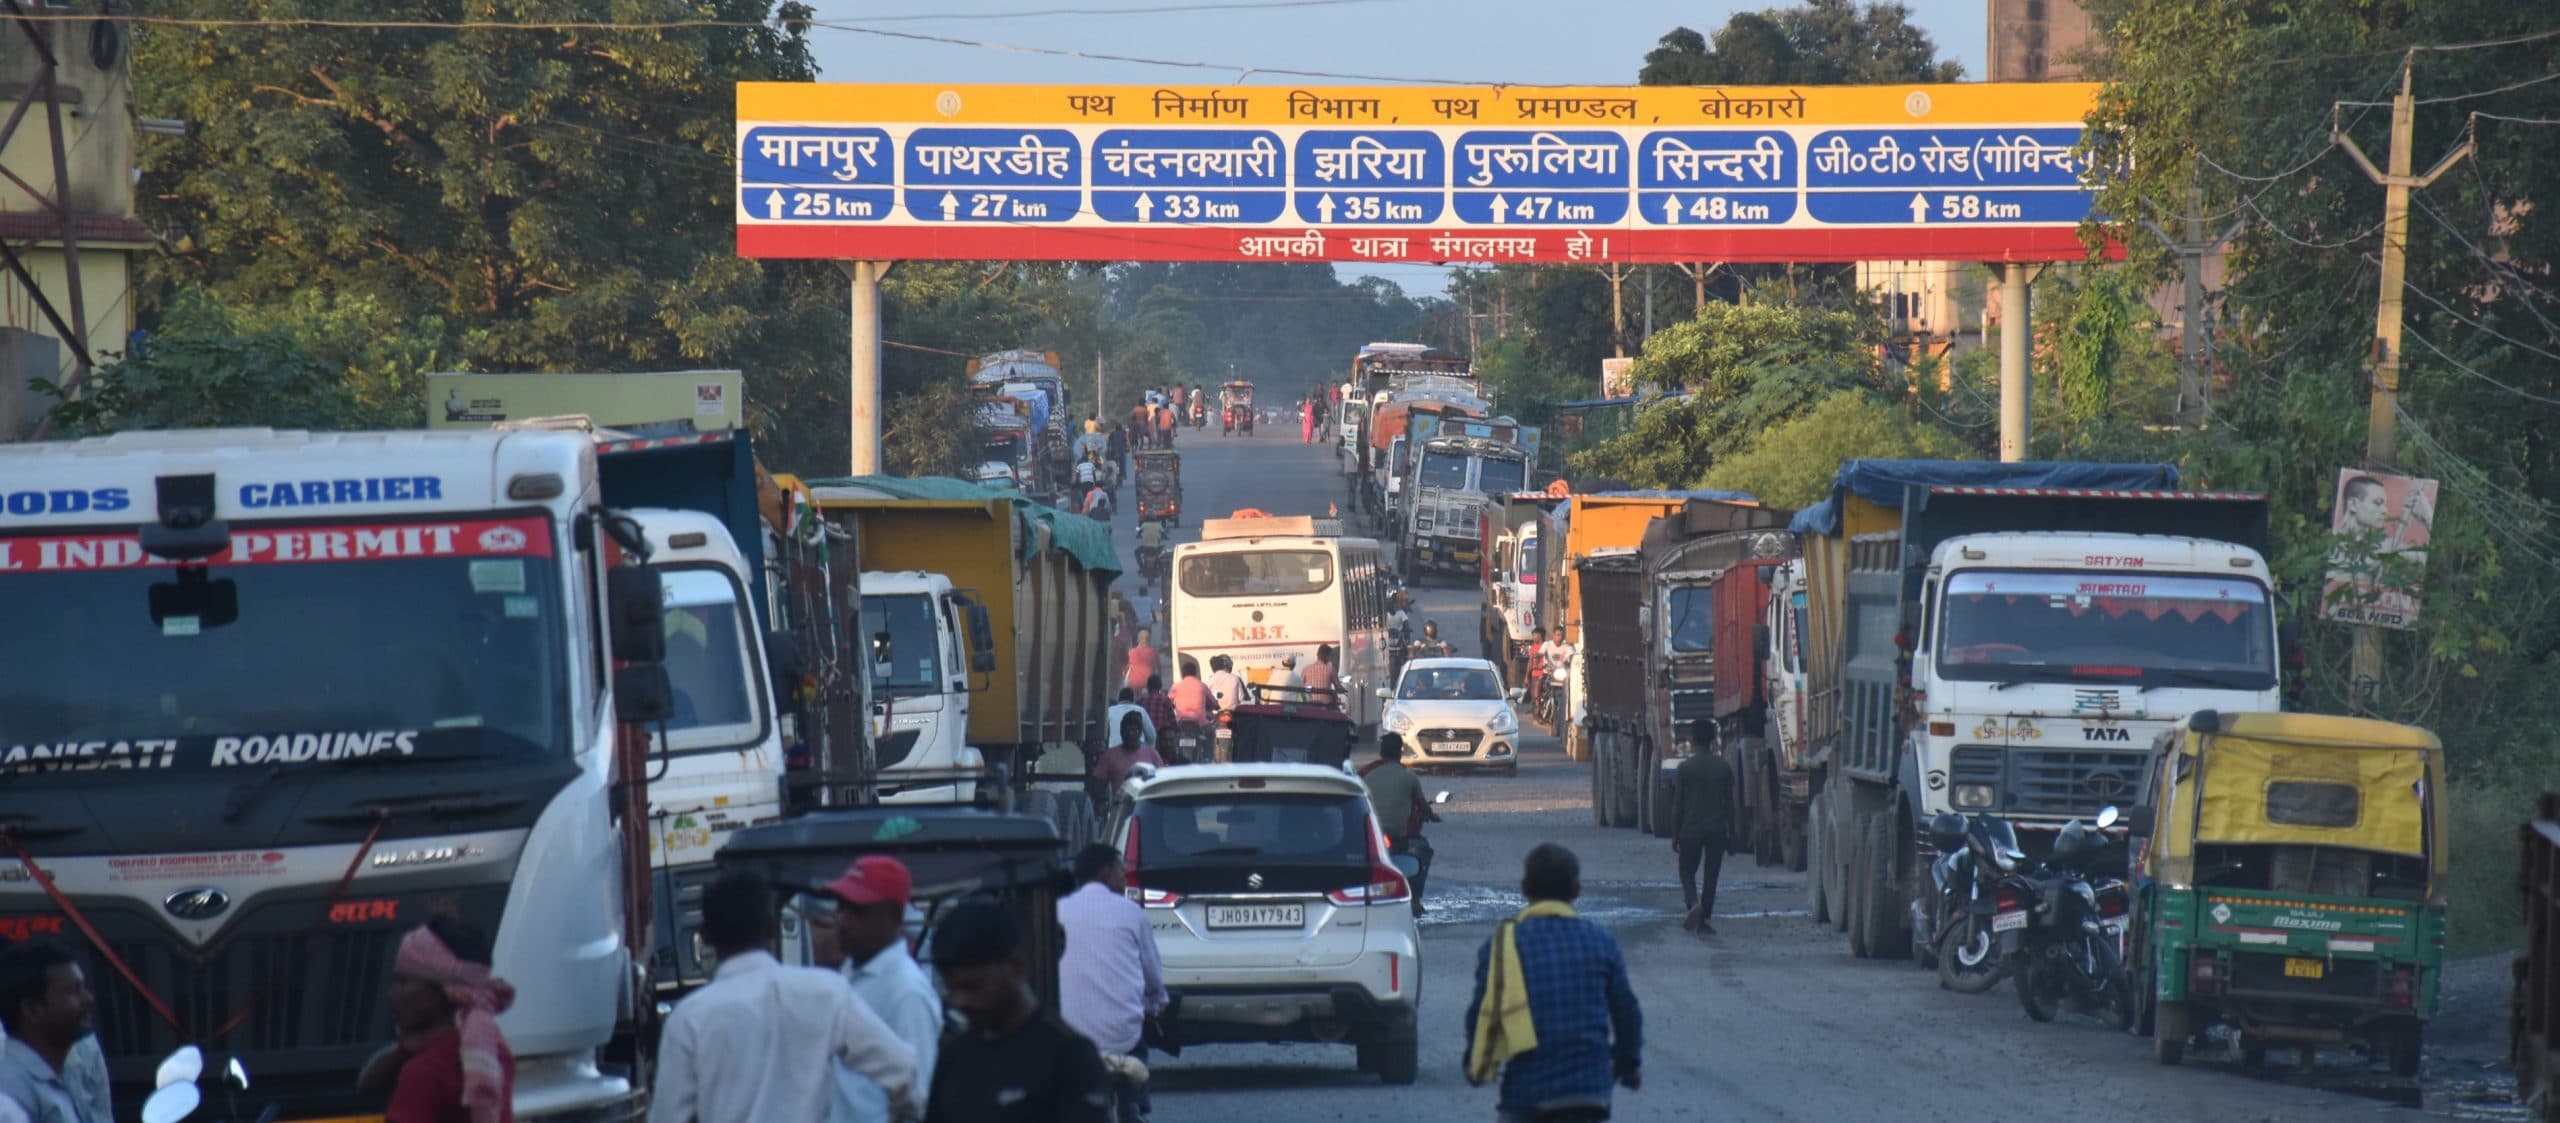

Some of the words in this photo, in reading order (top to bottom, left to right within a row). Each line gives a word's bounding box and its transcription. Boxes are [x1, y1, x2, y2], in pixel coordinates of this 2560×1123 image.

[1067, 95, 1116, 116] पथ
[1152, 89, 1249, 118] निर्माण
[1432, 99, 1480, 119] पथ
[1699, 89, 1807, 119] बोकारो
[757, 135, 880, 181] मानपुर
[916, 134, 1070, 179] पाथरडीह
[1101, 136, 1277, 178] चंदनक्यारी
[1312, 136, 1426, 182] झरिया
[1464, 132, 1619, 187] पुरूलिया
[1653, 136, 1783, 181] सिन्दरी
[793, 193, 831, 216] 25
[835, 197, 872, 217] km
[971, 194, 1008, 217] 27
[1012, 198, 1047, 217] km
[1164, 195, 1201, 219] 33
[1205, 199, 1240, 219] km
[1344, 197, 1380, 220] 35
[1385, 201, 1422, 220] km
[1516, 197, 1553, 220] 47
[1557, 201, 1595, 220] km
[1689, 197, 1727, 221] 48
[1732, 201, 1769, 220] km
[1942, 195, 1980, 219] 58
[1984, 200, 2021, 219] km
[1239, 231, 1325, 257] आपकी
[1351, 235, 1408, 257] यात्रा
[1432, 231, 1536, 257] मंगलमय
[0, 488, 130, 515] ODS
[240, 476, 442, 509] CARRIER
[38, 538, 209, 569] IND
[229, 524, 461, 563] PERMIT
[1231, 625, 1289, 641] N.B.T.
[2082, 727, 2130, 741] TATA
[0, 738, 177, 776] ANISATI
[211, 730, 418, 767] ROADLINES
[1218, 902, 1300, 923] JH09AY7943
